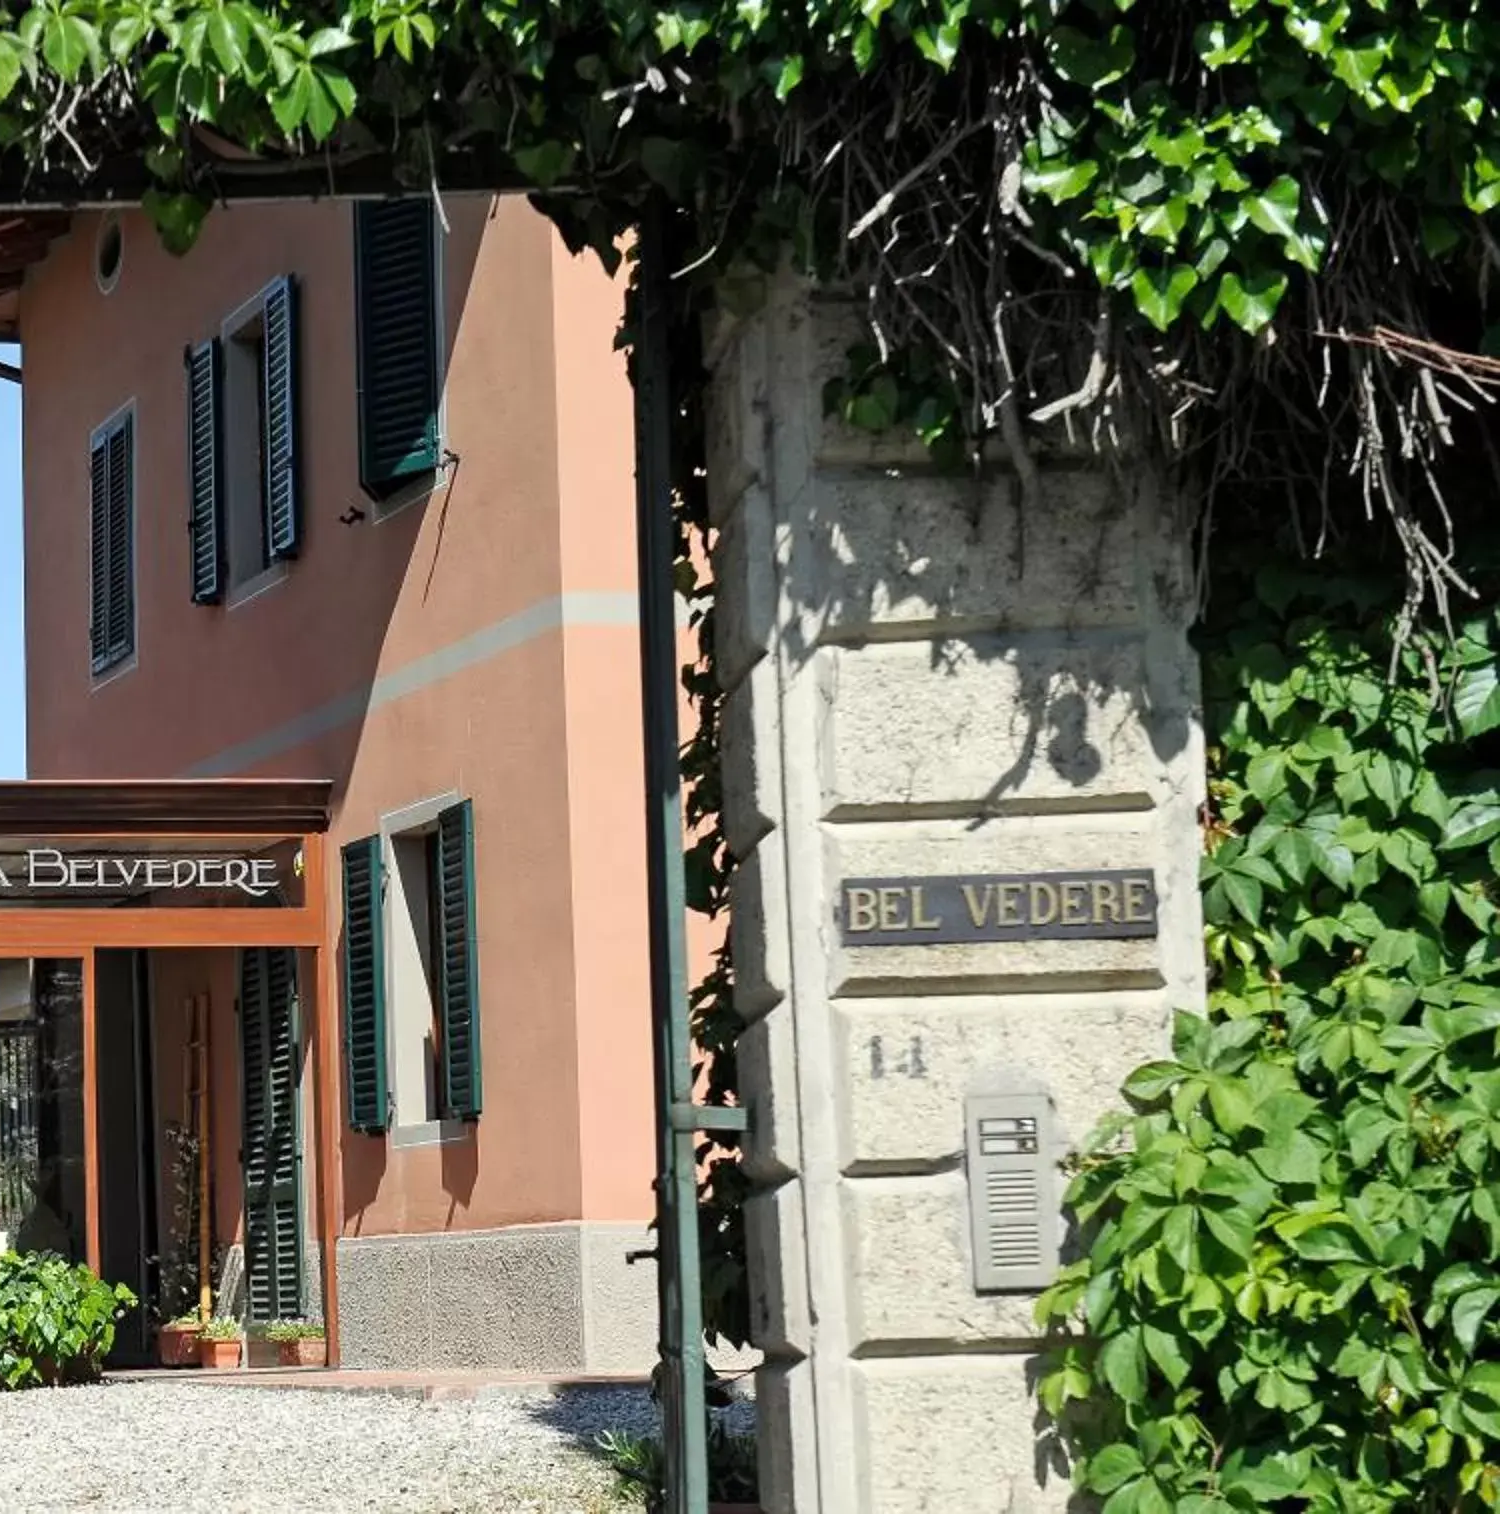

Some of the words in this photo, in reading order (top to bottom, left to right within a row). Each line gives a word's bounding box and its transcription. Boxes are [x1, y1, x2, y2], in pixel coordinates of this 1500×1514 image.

[26, 849, 280, 896] BELVEDERE
[846, 885, 942, 932] BEL
[960, 878, 1154, 928] VEDERE
